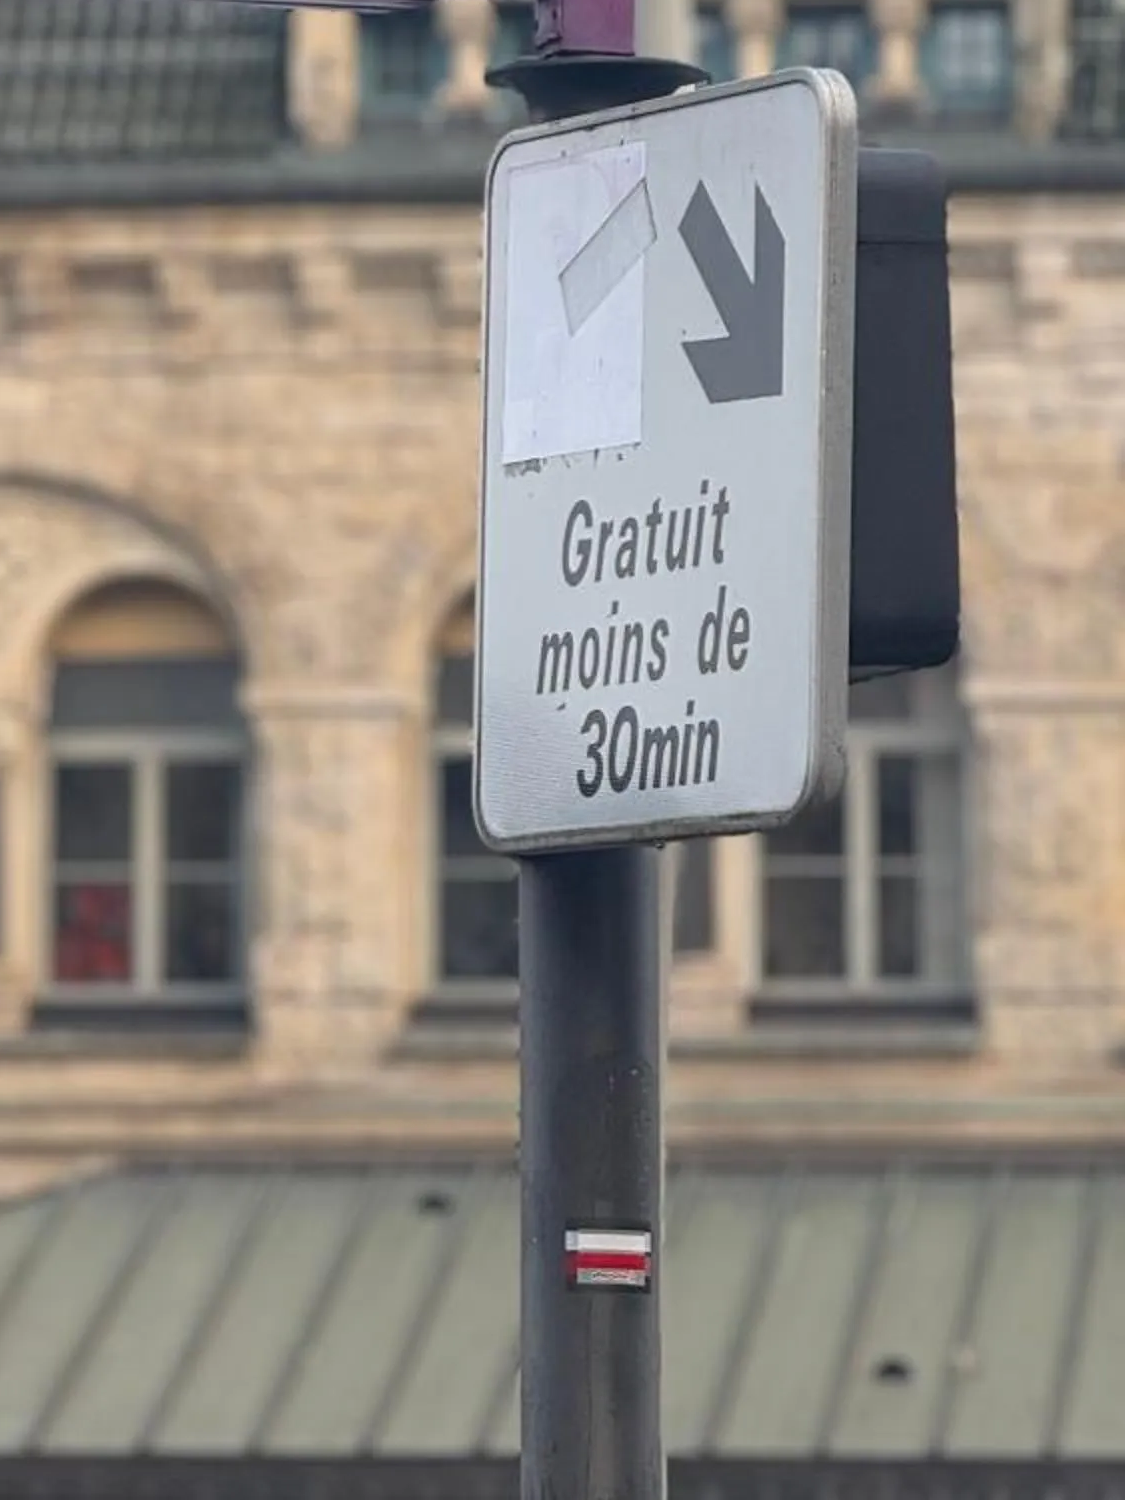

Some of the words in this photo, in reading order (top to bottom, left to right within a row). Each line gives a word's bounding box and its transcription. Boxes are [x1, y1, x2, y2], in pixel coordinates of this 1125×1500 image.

[561, 480, 731, 587] Gratuit
[536, 601, 669, 695] moins
[697, 585, 751, 675] de
[576, 700, 720, 798] 30min
